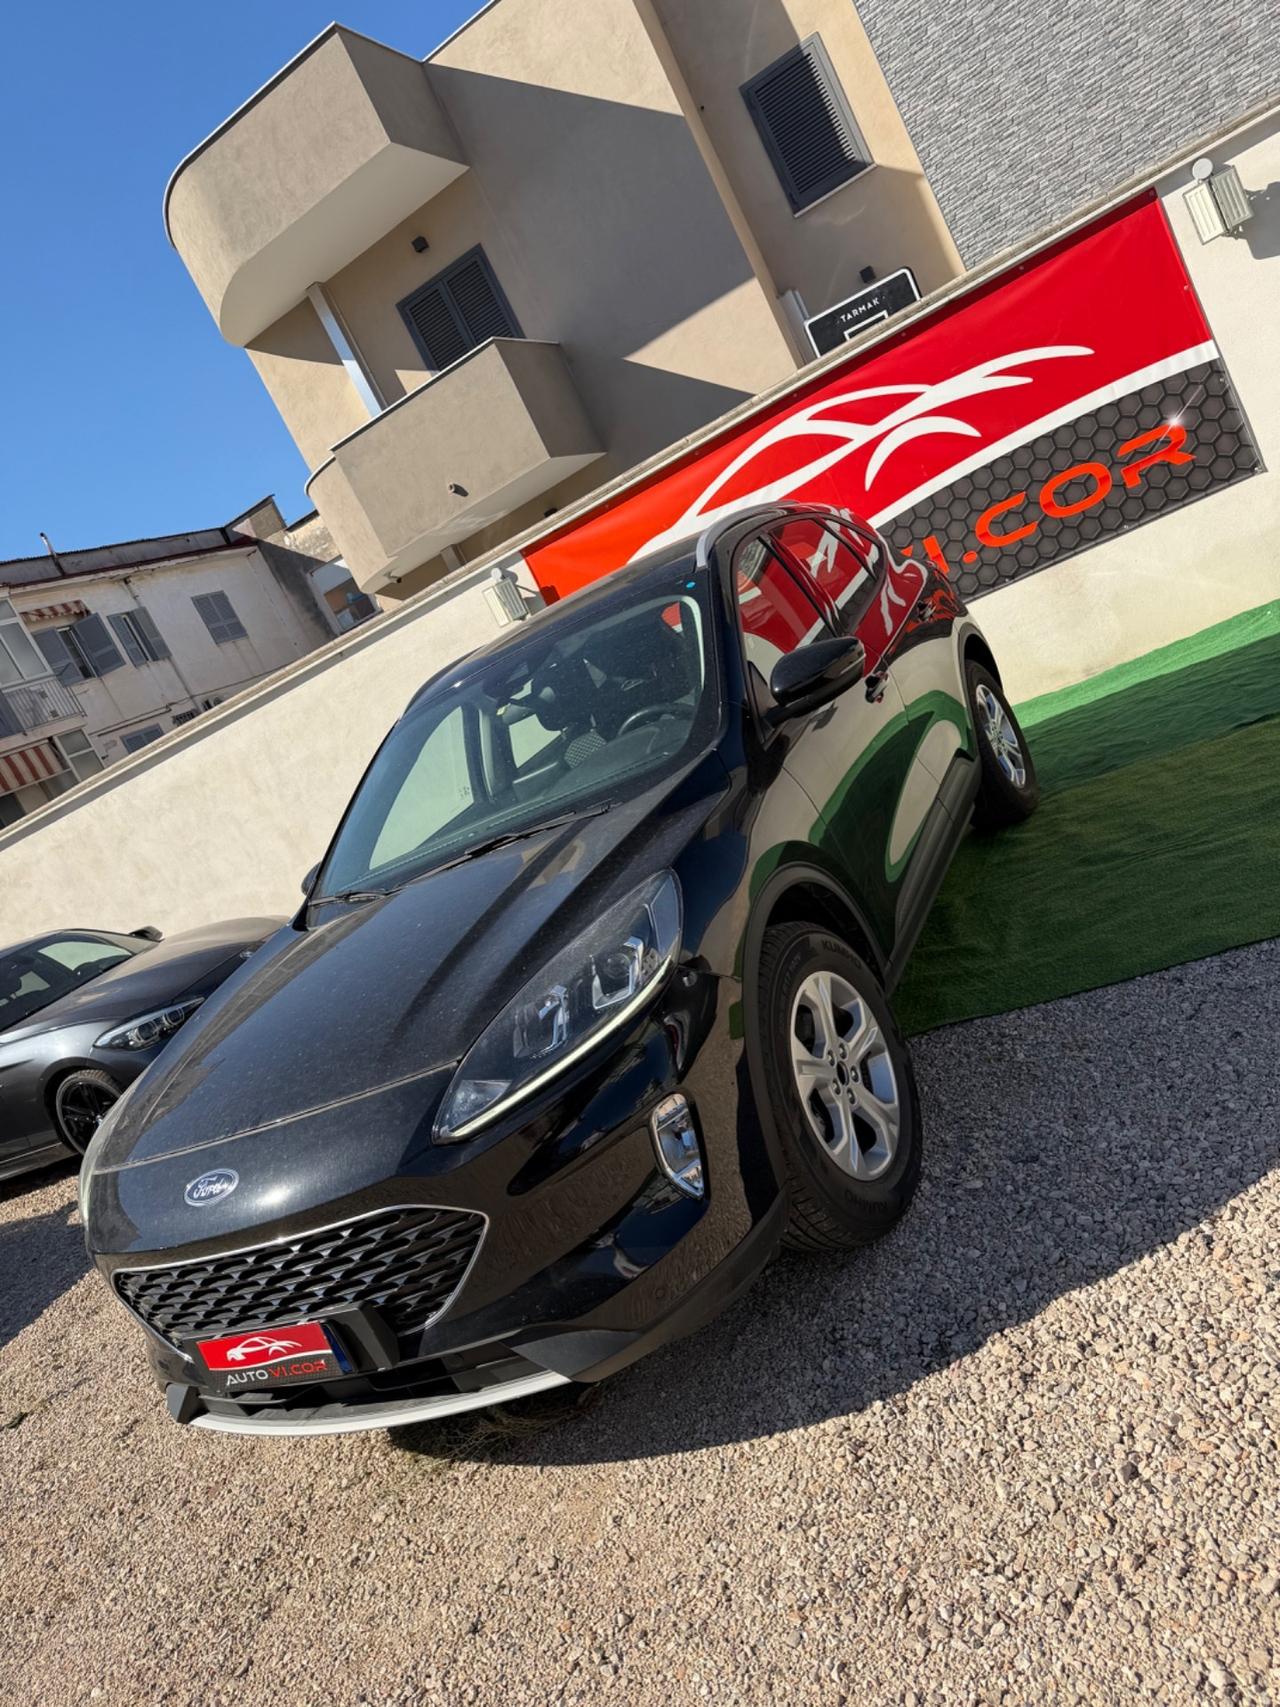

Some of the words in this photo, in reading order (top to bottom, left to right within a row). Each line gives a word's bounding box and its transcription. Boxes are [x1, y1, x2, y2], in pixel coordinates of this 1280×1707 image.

[840, 297, 880, 322] TARMAK
[901, 422, 1196, 576] I.COR
[821, 939, 862, 970] KUMHO
[193, 1175, 233, 1199] Ford
[225, 1369, 269, 1387] AUTO
[269, 1359, 327, 1378] VI.COR
